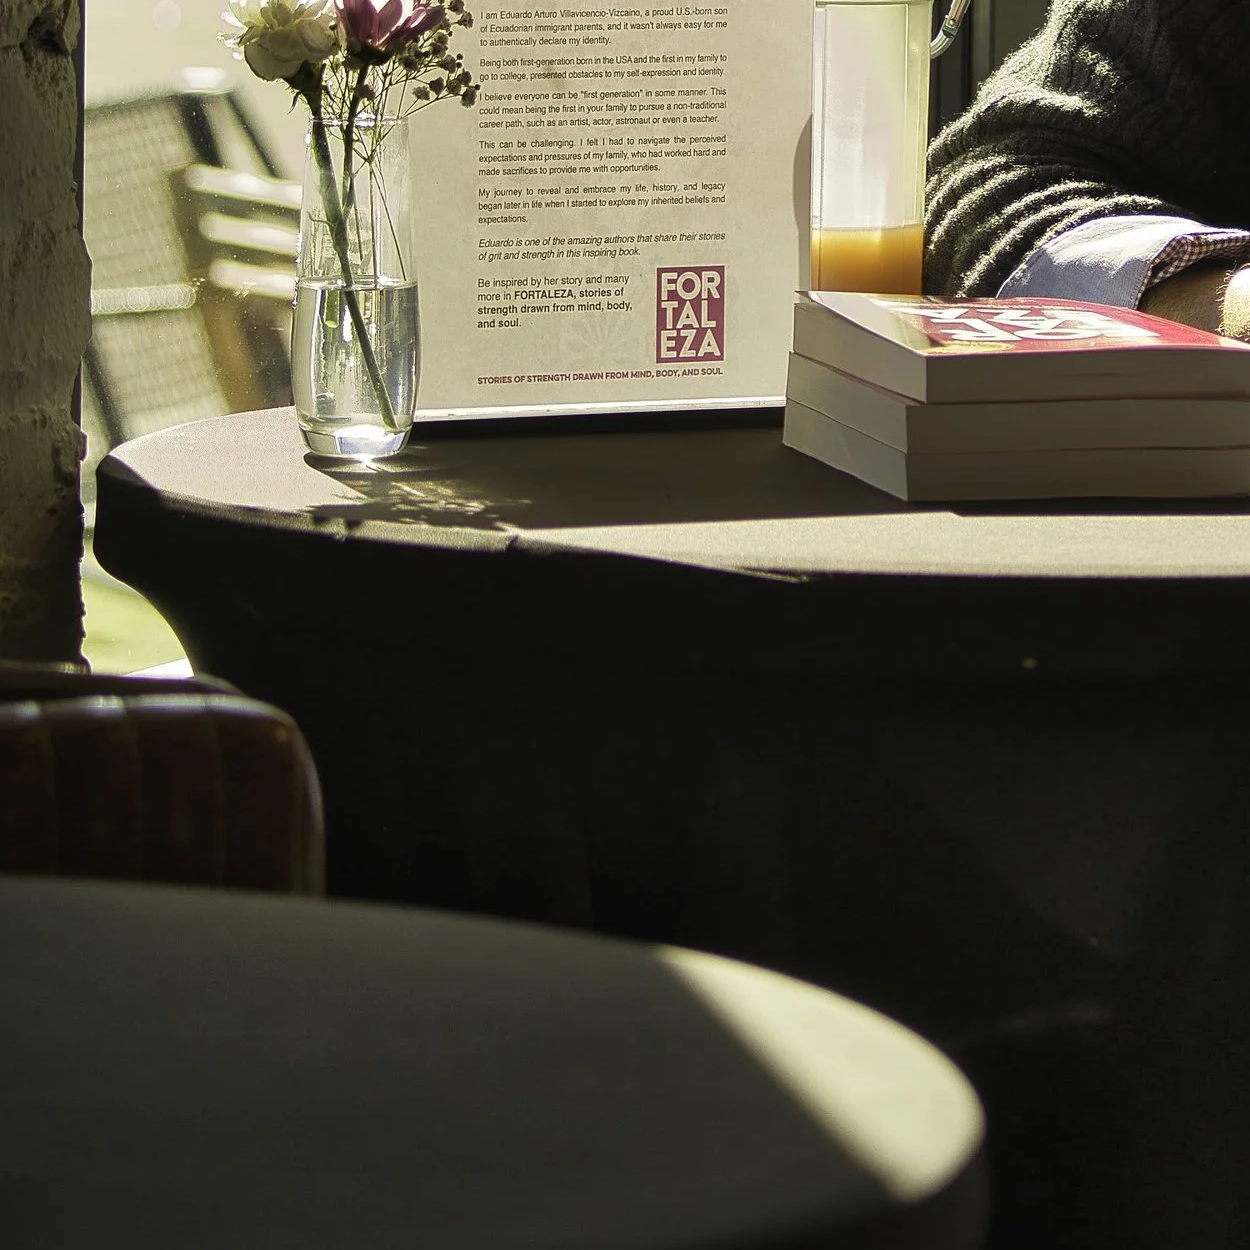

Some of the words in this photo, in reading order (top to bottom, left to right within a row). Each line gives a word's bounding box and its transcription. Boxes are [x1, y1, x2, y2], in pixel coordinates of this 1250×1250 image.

[485, 12, 497, 20] am
[499, 10, 532, 20] Eduardo
[533, 9, 557, 19] Arturo
[559, 8, 642, 20] Villavicencio-Vizcaino,
[651, 7, 673, 19] proud
[675, 6, 712, 16] U.S.-born
[713, 8, 727, 16] son
[479, 23, 487, 33] of
[489, 23, 533, 33] Ecuadorian
[534, 22, 572, 34] immigrant
[573, 21, 605, 33] parents,
[606, 21, 621, 31] and
[623, 21, 628, 30] it
[629, 20, 654, 30] wasn't
[655, 20, 681, 32] always
[683, 21, 702, 31] easy
[703, 19, 714, 29] for
[715, 21, 727, 29] me
[479, 37, 487, 46] to
[489, 36, 537, 48] authentically
[538, 36, 566, 46] declare
[568, 38, 580, 47] my
[582, 35, 610, 47] identity.
[479, 73, 489, 83] go
[490, 71, 498, 81] to
[499, 70, 528, 83] college,
[529, 70, 566, 82] presented
[567, 69, 603, 79] obstacles
[604, 69, 612, 78] to
[613, 71, 625, 80] my
[626, 67, 681, 80] self-expression
[682, 67, 696, 77] and
[697, 66, 725, 78] identity.
[484, 91, 512, 101] believe
[513, 93, 549, 103] everyone
[551, 92, 566, 100] can
[568, 90, 578, 99] be
[580, 89, 598, 99] "first
[599, 88, 642, 101] generation"
[645, 88, 652, 98] in
[654, 90, 675, 98] some
[677, 89, 707, 97] manner.
[711, 87, 726, 96] This
[478, 105, 500, 115] could
[501, 107, 523, 115] mean
[524, 104, 546, 116] being
[547, 104, 560, 114] the
[561, 104, 576, 113] first
[577, 103, 585, 113] in
[586, 105, 603, 115] your
[605, 102, 628, 114] family
[629, 102, 637, 112] to
[638, 104, 664, 114] pursue
[672, 100, 726, 111] non-traditional
[478, 152, 526, 165] expectations
[528, 152, 543, 162] and
[544, 153, 581, 163] pressures
[582, 151, 590, 160] of
[592, 152, 604, 162] my
[605, 150, 629, 162] family,
[630, 149, 647, 159] who
[648, 149, 662, 159] had
[663, 148, 691, 158] worked
[692, 148, 710, 158] hard
[711, 147, 726, 157] and
[478, 166, 500, 176] made
[502, 165, 538, 175] sacrifices
[539, 165, 547, 174] to
[548, 164, 577, 176] provide
[578, 166, 591, 174] me
[592, 163, 608, 173] with
[609, 162, 660, 175] opportunities.
[478, 187, 490, 199] My
[493, 187, 522, 199] journey
[525, 186, 533, 196] to
[537, 186, 561, 195] reveal
[564, 185, 579, 195] and
[582, 184, 616, 194] embrace
[619, 186, 631, 196] my
[634, 184, 648, 194] life,
[652, 183, 679, 195] history,
[682, 182, 697, 192] and
[701, 182, 725, 194] legacy
[477, 213, 528, 226] expectations.
[478, 238, 514, 248] Eduardo
[515, 238, 522, 247] is
[523, 239, 540, 247] one
[541, 237, 550, 246] of
[551, 236, 565, 246] the
[567, 235, 602, 248] amazing
[603, 234, 635, 244] authors
[636, 234, 652, 243] that
[653, 233, 677, 243] share
[678, 232, 696, 242] their
[698, 231, 725, 242] stories
[478, 251, 486, 261] of
[488, 251, 502, 263] grit
[503, 250, 519, 260] and
[521, 249, 554, 262] strength
[556, 249, 564, 258] in
[565, 248, 581, 258] this
[582, 247, 617, 260] inspiring
[618, 246, 641, 256] book.
[477, 278, 490, 288] Be
[492, 277, 528, 290] inspired
[530, 277, 541, 289] by
[543, 276, 558, 286] her
[560, 275, 583, 288] story
[585, 275, 602, 285] and
[604, 276, 629, 286] many
[660, 270, 721, 300] FOR
[477, 293, 500, 301] more
[503, 291, 511, 301] in
[513, 289, 576, 301] FORTALEZA,
[578, 287, 611, 298] stories
[613, 287, 623, 297] of
[477, 305, 517, 317] strength
[520, 304, 550, 314] drawn
[552, 303, 574, 313] from
[577, 302, 604, 314] mind,
[606, 301, 632, 314] body,
[660, 299, 717, 329] TAL
[477, 319, 495, 329] and
[498, 318, 521, 328] soul.
[660, 328, 721, 358] EZA
[477, 375, 512, 385] STORIES
[513, 375, 525, 384] OF
[526, 373, 571, 383] STRENGTH
[572, 371, 603, 381] DRAWN
[605, 370, 629, 380] FROM
[630, 369, 654, 380] MIND,
[655, 368, 680, 379] BODY,
[681, 368, 699, 377] AND
[700, 367, 723, 376] SOUL
